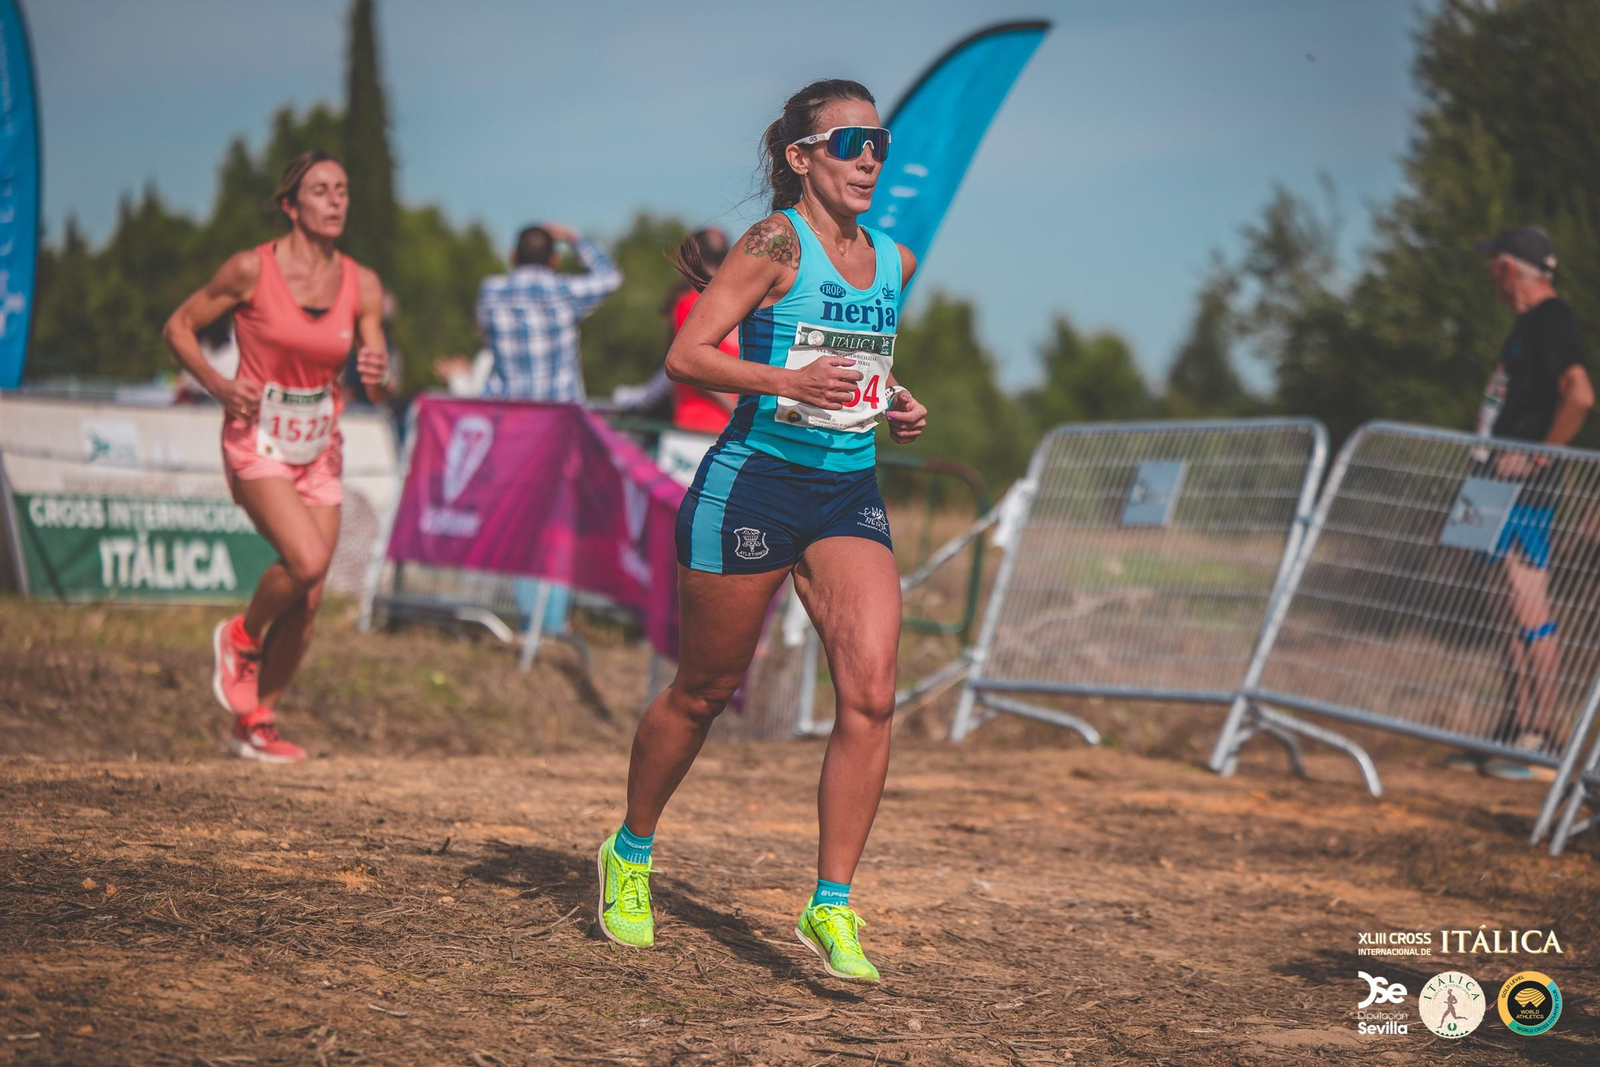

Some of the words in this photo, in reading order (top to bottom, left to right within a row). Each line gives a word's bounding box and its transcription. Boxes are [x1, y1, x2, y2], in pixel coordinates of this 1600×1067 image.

[821, 285, 846, 296] TROPS
[820, 298, 895, 332] nerja
[831, 335, 875, 350] ITÁLICA
[28, 497, 103, 530] CROSS
[99, 533, 237, 591] ITÁLICA
